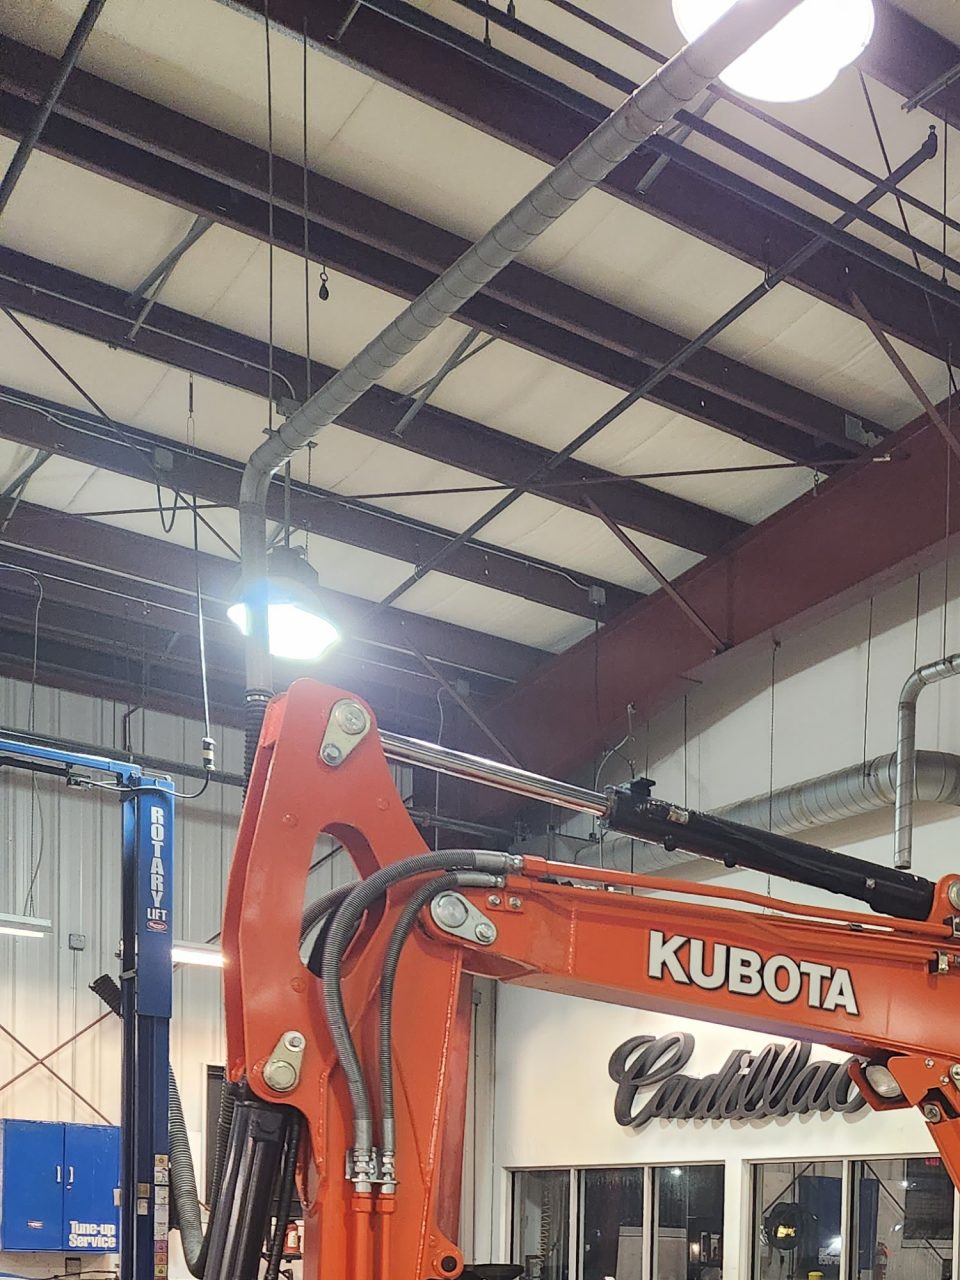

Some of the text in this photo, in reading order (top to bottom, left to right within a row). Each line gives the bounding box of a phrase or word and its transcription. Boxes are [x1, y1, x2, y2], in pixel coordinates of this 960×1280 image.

[150, 805, 164, 908] ROTARY
[146, 907, 168, 921] LIFT
[648, 929, 860, 1016] KUBOTA
[608, 1031, 871, 1127] Cadillac
[68, 1233, 117, 1249] Service
[69, 1220, 117, 1237] Tune-up
